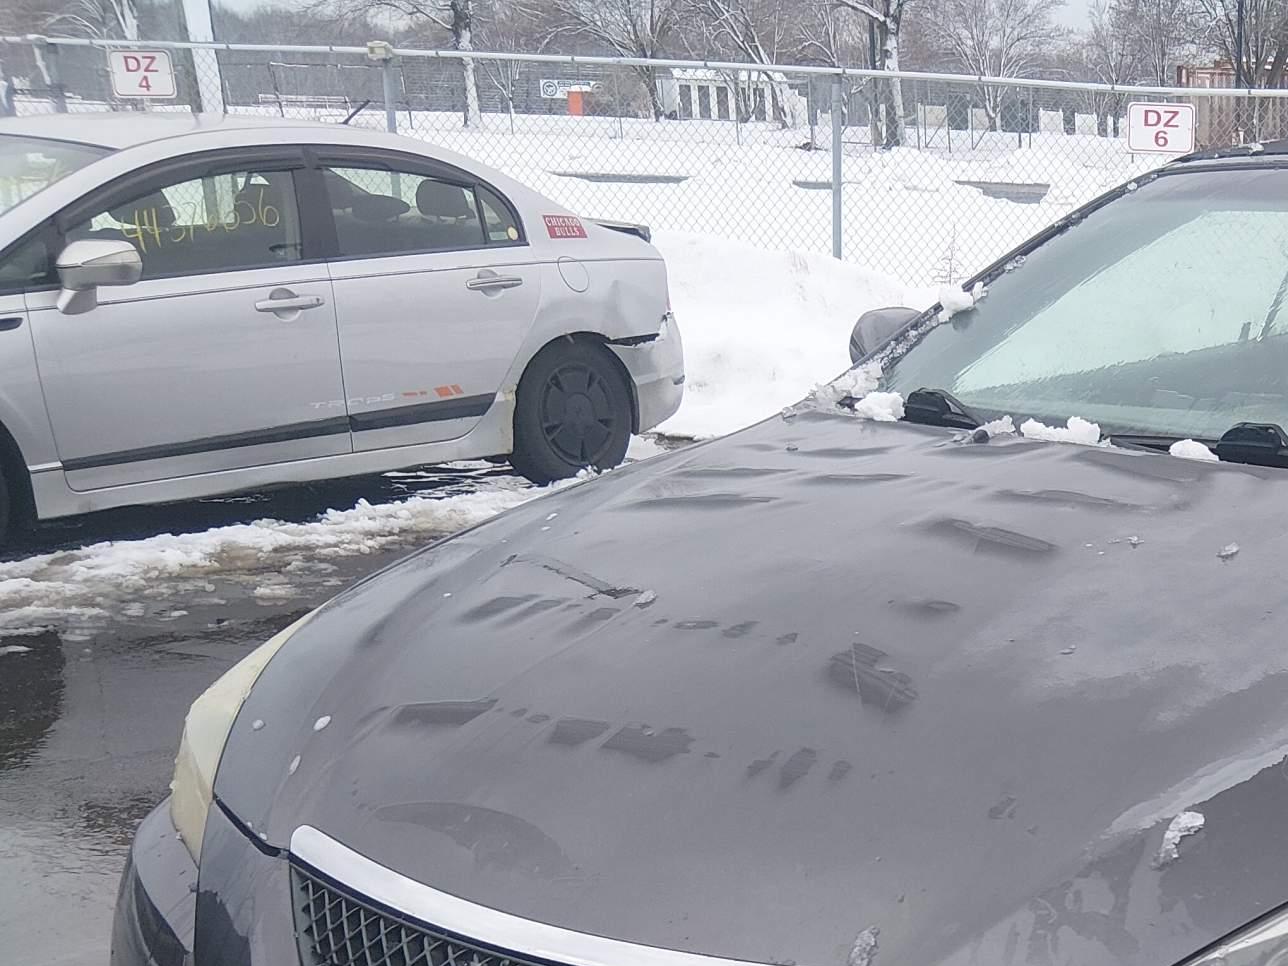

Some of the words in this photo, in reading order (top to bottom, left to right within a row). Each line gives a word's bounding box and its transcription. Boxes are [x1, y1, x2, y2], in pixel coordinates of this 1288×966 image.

[123, 55, 159, 73] DZ
[138, 75, 152, 91] 4
[1144, 110, 1180, 128] DZ
[1154, 130, 1169, 147] 6
[545, 216, 580, 227] CHICAGO
[555, 227, 580, 236] BULLS
